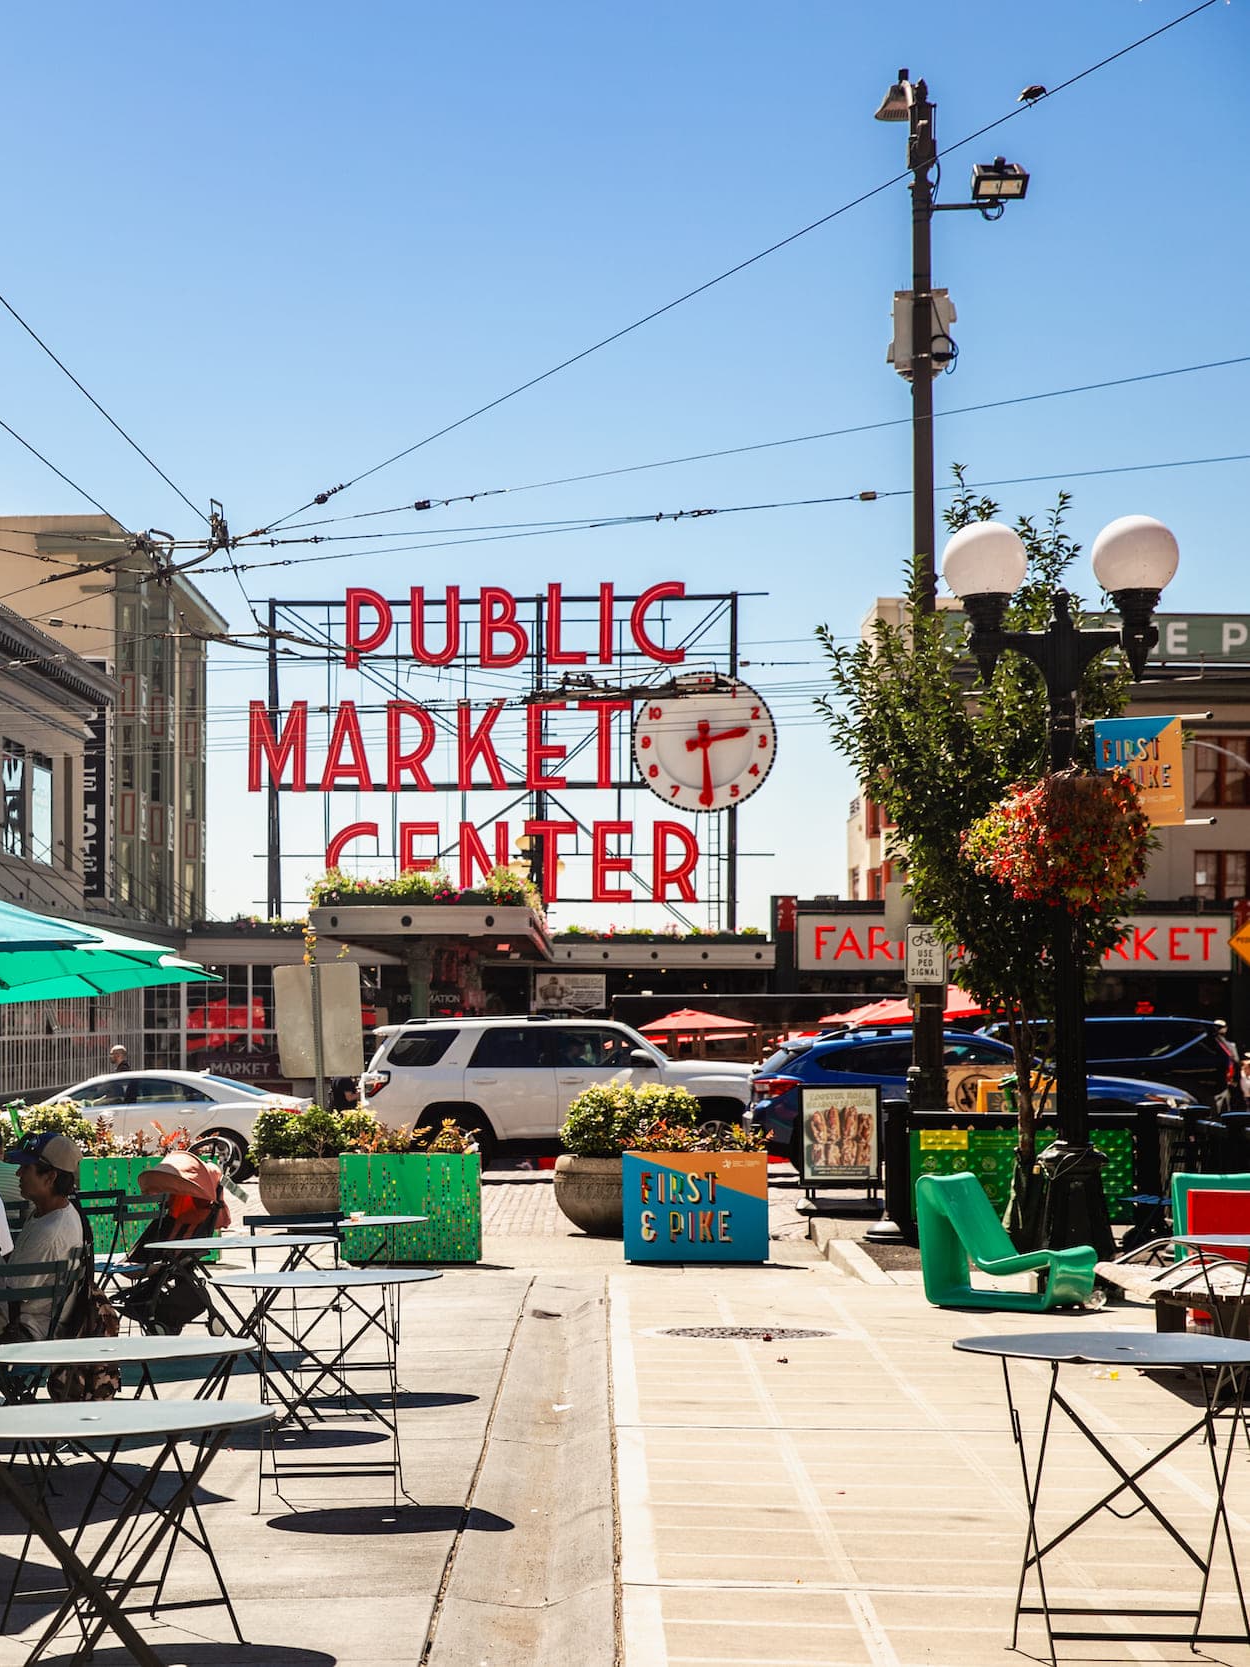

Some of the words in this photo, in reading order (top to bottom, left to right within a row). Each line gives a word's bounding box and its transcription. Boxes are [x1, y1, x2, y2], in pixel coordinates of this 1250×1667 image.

[345, 582, 685, 668] PUBLIC
[648, 707, 662, 720] 10
[751, 706, 760, 720] 2
[248, 698, 632, 792] MARKET
[641, 735, 651, 749] 9
[758, 735, 768, 749] 3
[1103, 737, 1159, 762] FIRST
[648, 764, 659, 778] 8
[748, 763, 760, 777] 4
[670, 785, 681, 798] 7
[730, 784, 740, 797] 5
[325, 820, 699, 903] CENTER
[918, 949, 933, 957] USE
[918, 959, 933, 967] PED
[911, 968, 939, 976] SIGNAL
[210, 1062, 270, 1075] MARKET
[640, 1171, 719, 1204] FIRST
[640, 1210, 658, 1243] &
[669, 1210, 734, 1243] PIKE
